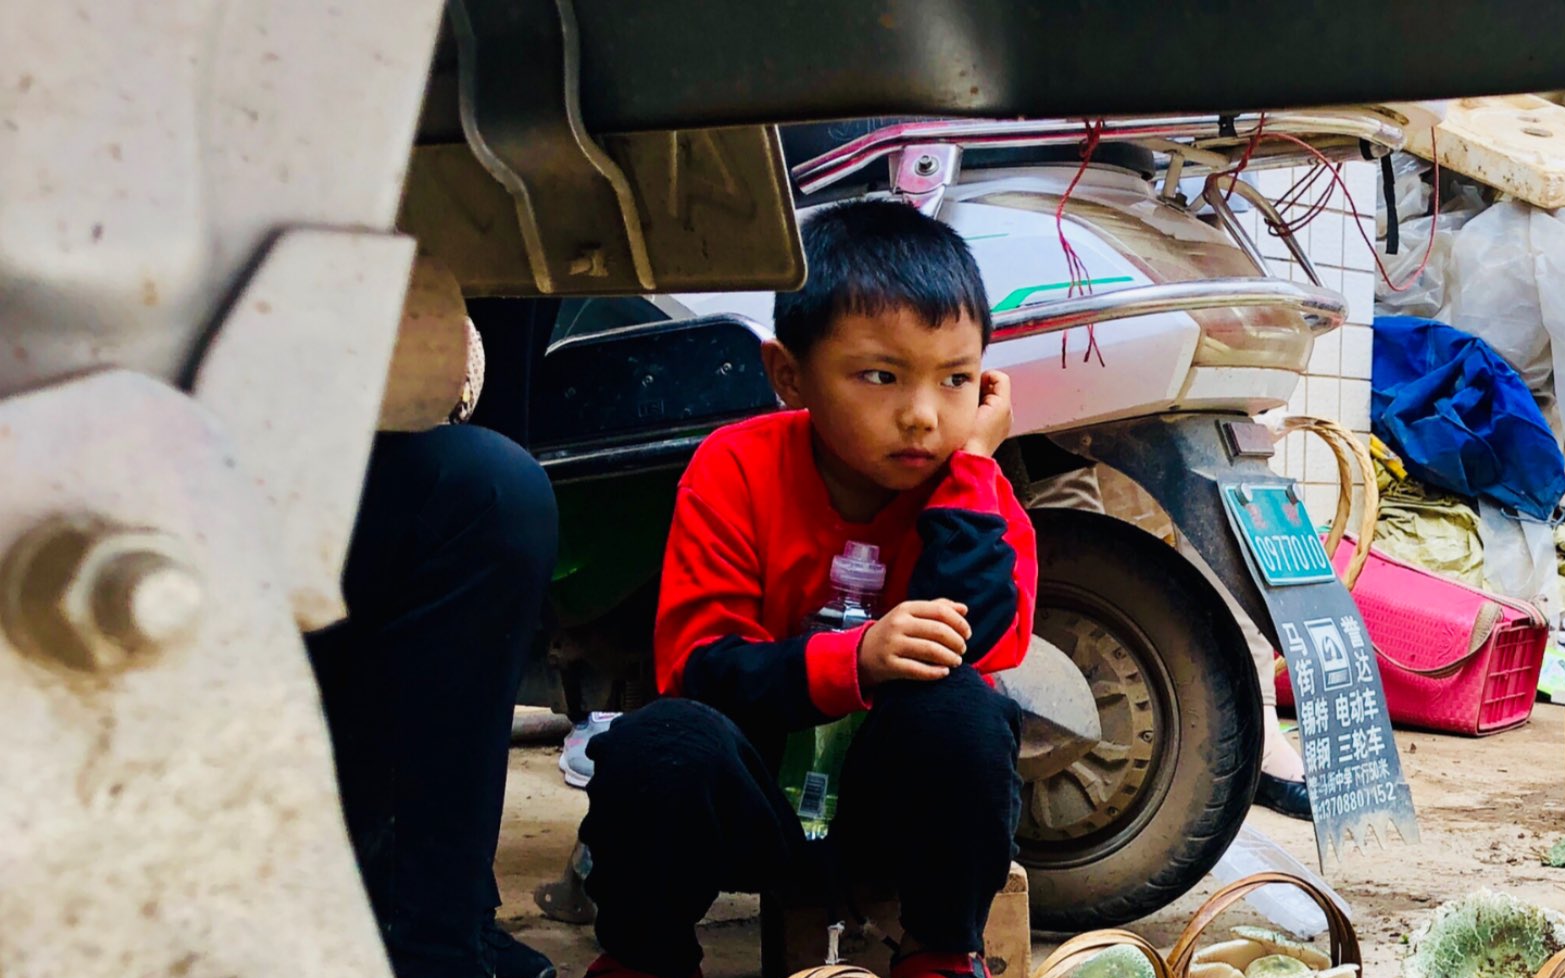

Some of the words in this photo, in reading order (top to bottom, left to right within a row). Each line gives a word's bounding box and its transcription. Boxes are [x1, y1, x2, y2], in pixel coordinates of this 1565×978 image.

[1255, 535, 1327, 572] 0977010
[1335, 687, 1379, 728] 电动车
[1338, 725, 1385, 763] 三轮车
